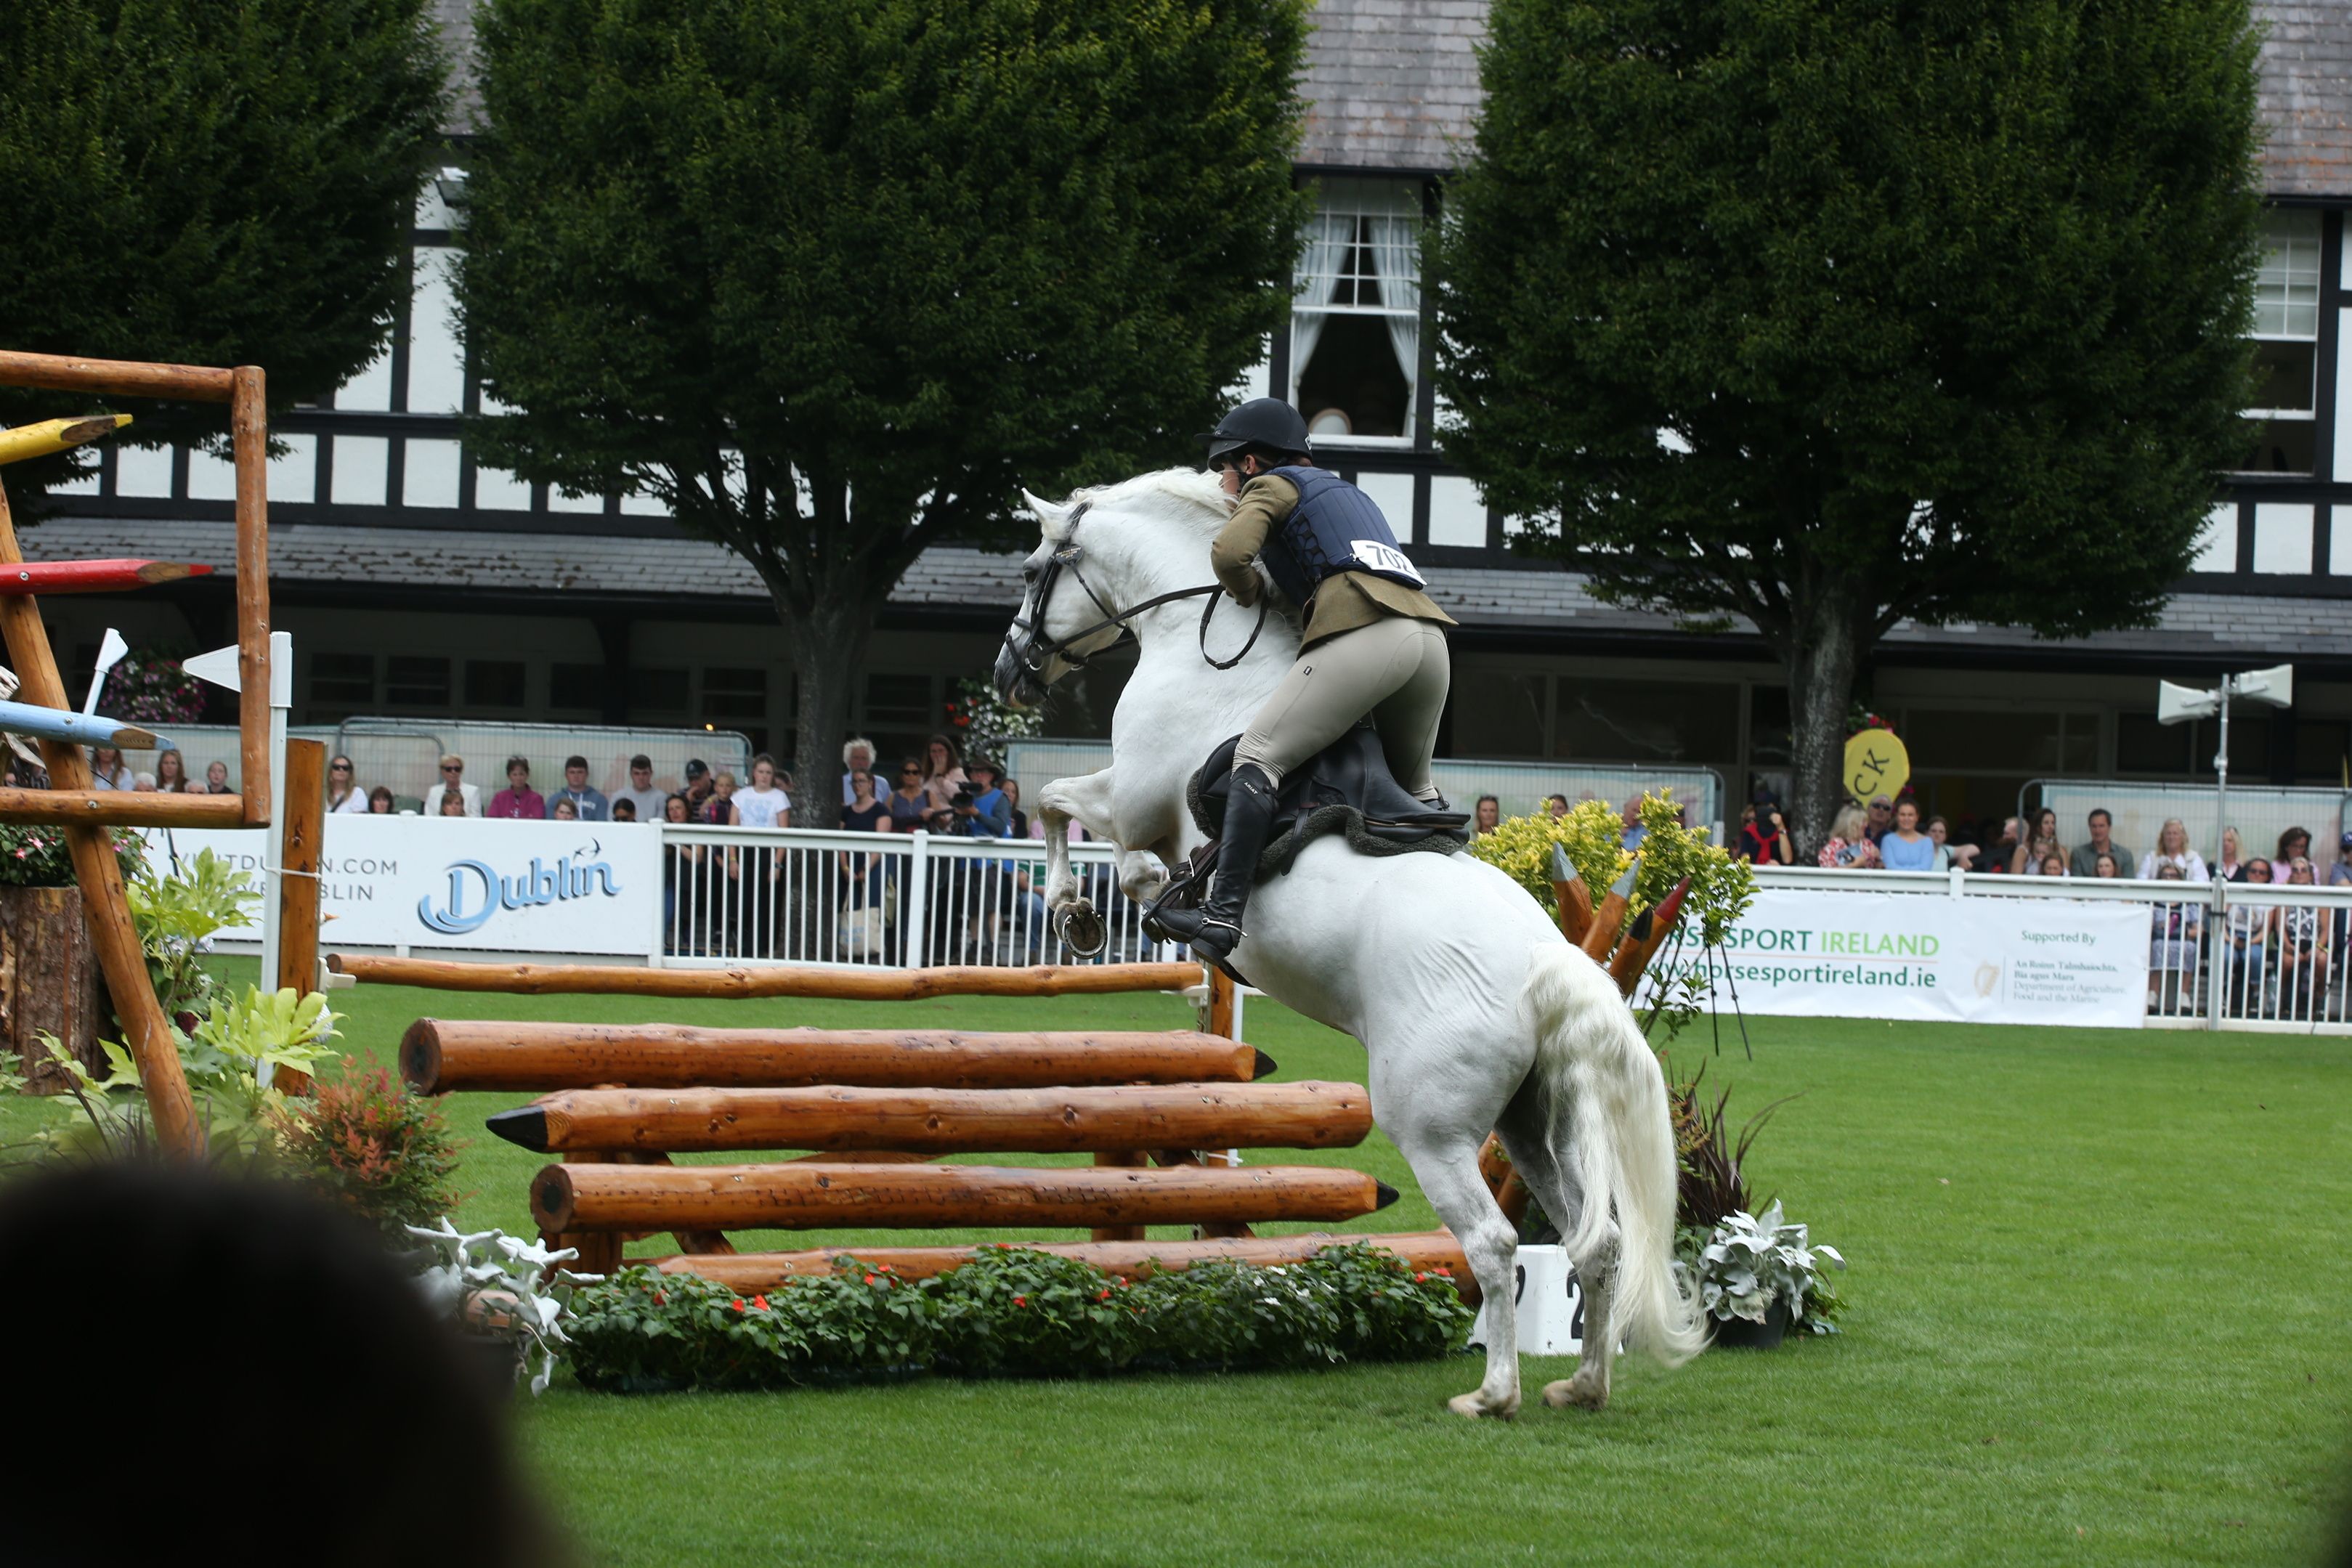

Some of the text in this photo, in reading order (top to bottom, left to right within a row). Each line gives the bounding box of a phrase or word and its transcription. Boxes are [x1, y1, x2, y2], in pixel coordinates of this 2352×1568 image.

[1366, 545, 1415, 576] 702
[417, 859, 623, 935] Dublin
[1820, 931, 1939, 956] IRELAND
[2021, 930, 2096, 946] Supported By
